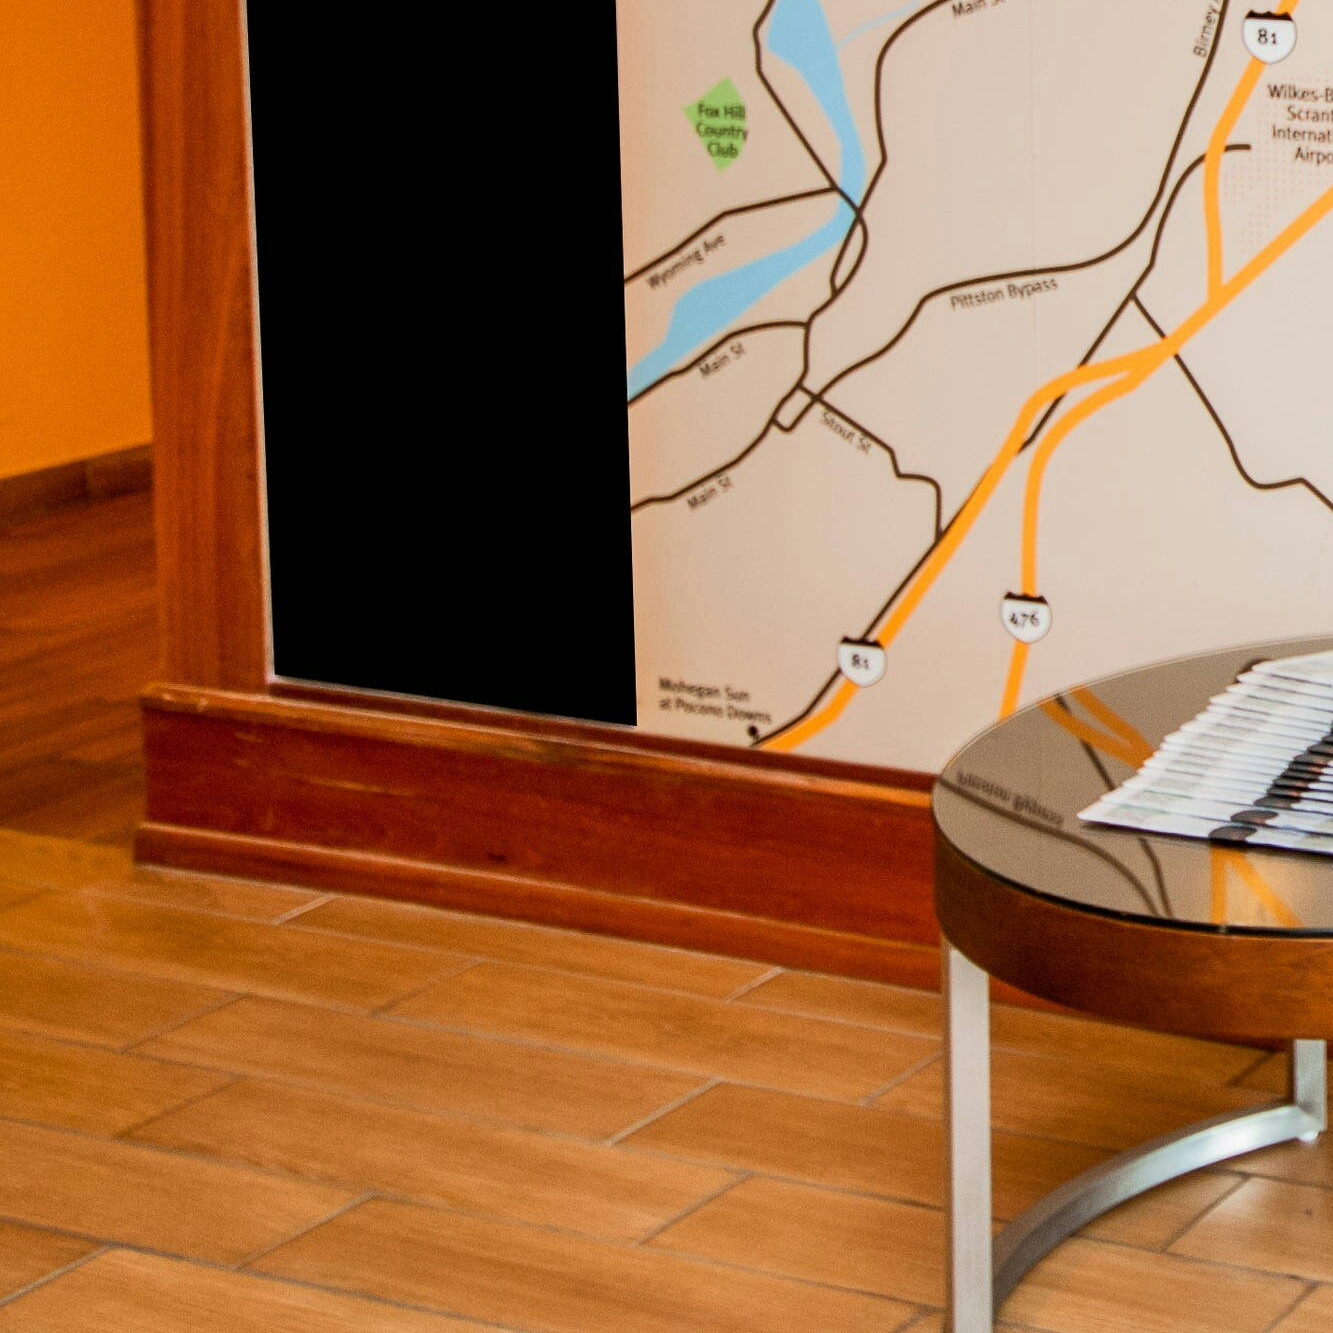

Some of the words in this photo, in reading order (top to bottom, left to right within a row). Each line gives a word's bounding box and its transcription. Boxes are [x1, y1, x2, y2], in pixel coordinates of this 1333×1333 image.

[1193, 3, 1220, 57] Birney
[1257, 28, 1278, 46] 81
[698, 105, 720, 118] Fox
[724, 105, 746, 120] Hill
[696, 123, 749, 142] Country
[707, 142, 738, 158] Club
[646, 246, 704, 290] Wyoming
[702, 233, 726, 253] Ave
[951, 285, 1004, 311] Pittston
[1007, 277, 1058, 302] Bypass
[699, 350, 730, 379] Main
[727, 342, 746, 360] St
[820, 410, 855, 444] Stout
[853, 434, 872, 456] St
[686, 484, 719, 512] Main
[717, 476, 734, 493] St
[1009, 612, 1040, 628] 476
[850, 654, 870, 670] 81
[659, 677, 720, 698] Mohegan
[725, 685, 750, 702] Sun
[660, 698, 671, 710] at
[726, 706, 772, 724] Downs
